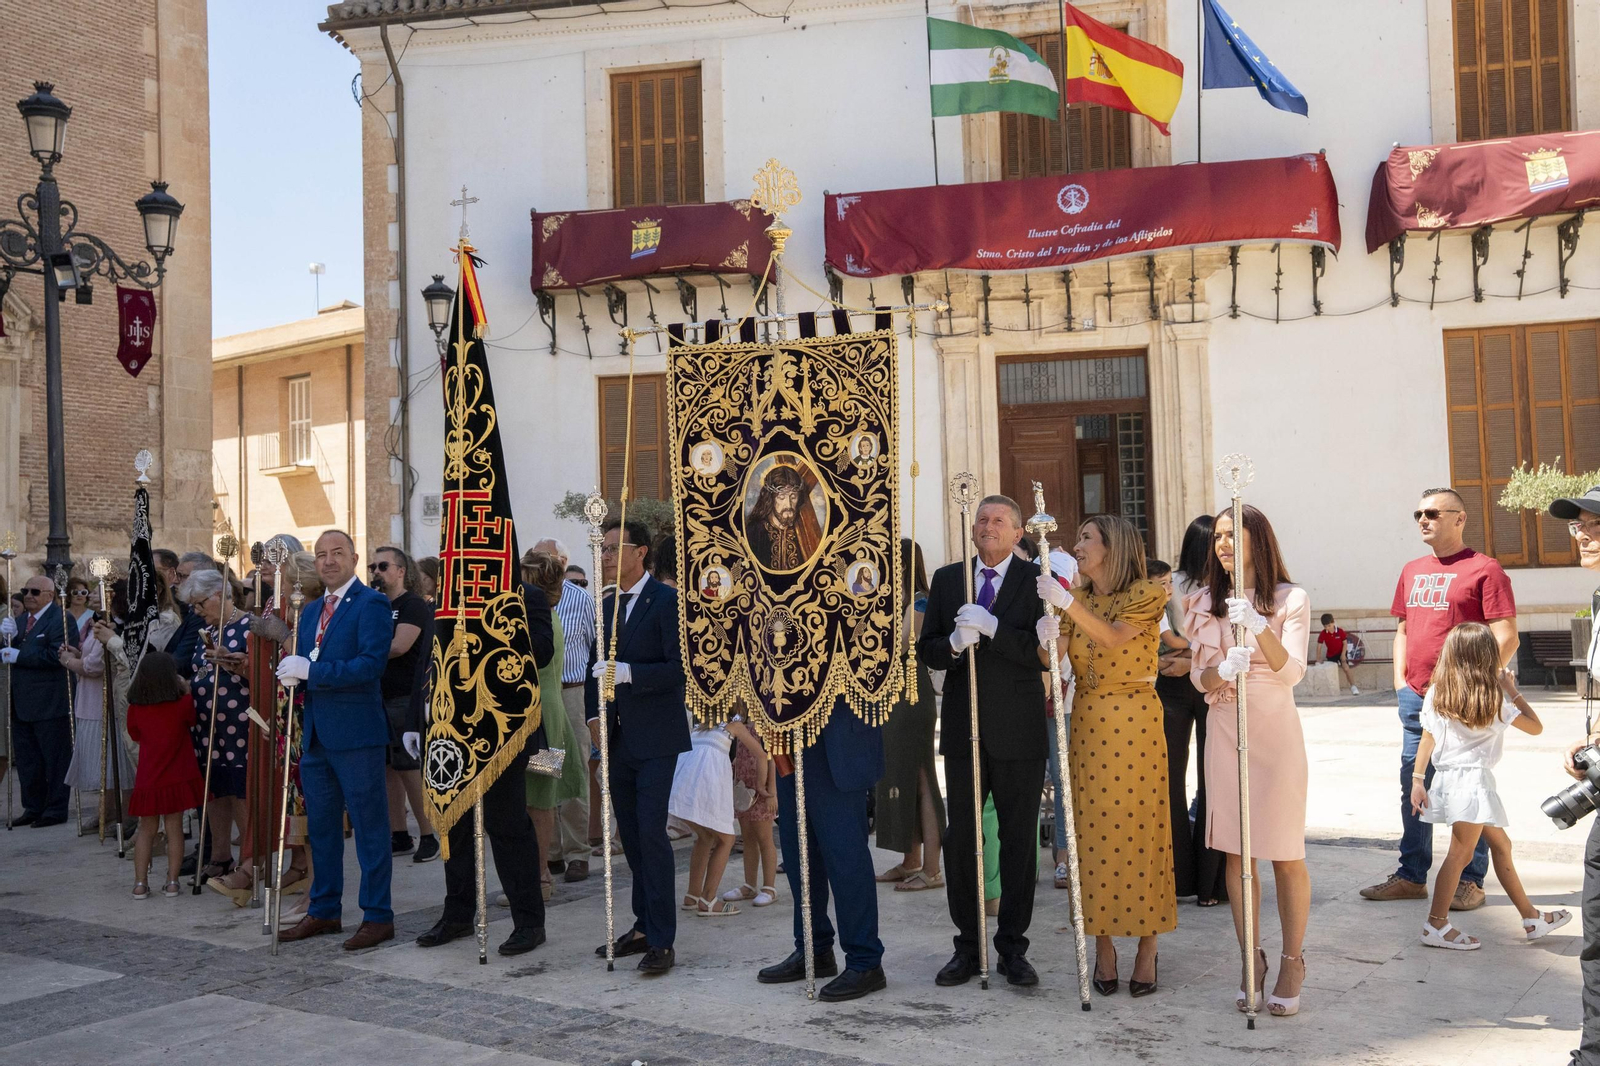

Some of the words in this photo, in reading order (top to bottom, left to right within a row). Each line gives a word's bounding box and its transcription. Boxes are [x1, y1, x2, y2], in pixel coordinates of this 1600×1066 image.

[1027, 229, 1058, 239] Ilustre
[1060, 221, 1103, 236] Cofradía
[1105, 219, 1121, 230] del
[976, 248, 1003, 259] Stmo.
[1006, 249, 1035, 259] Cristo
[1037, 247, 1052, 257] del
[1056, 243, 1091, 255] Perdón
[1092, 243, 1101, 252] y
[1102, 239, 1113, 248] de
[1115, 236, 1128, 245] los
[1129, 226, 1173, 243] Afligidos
